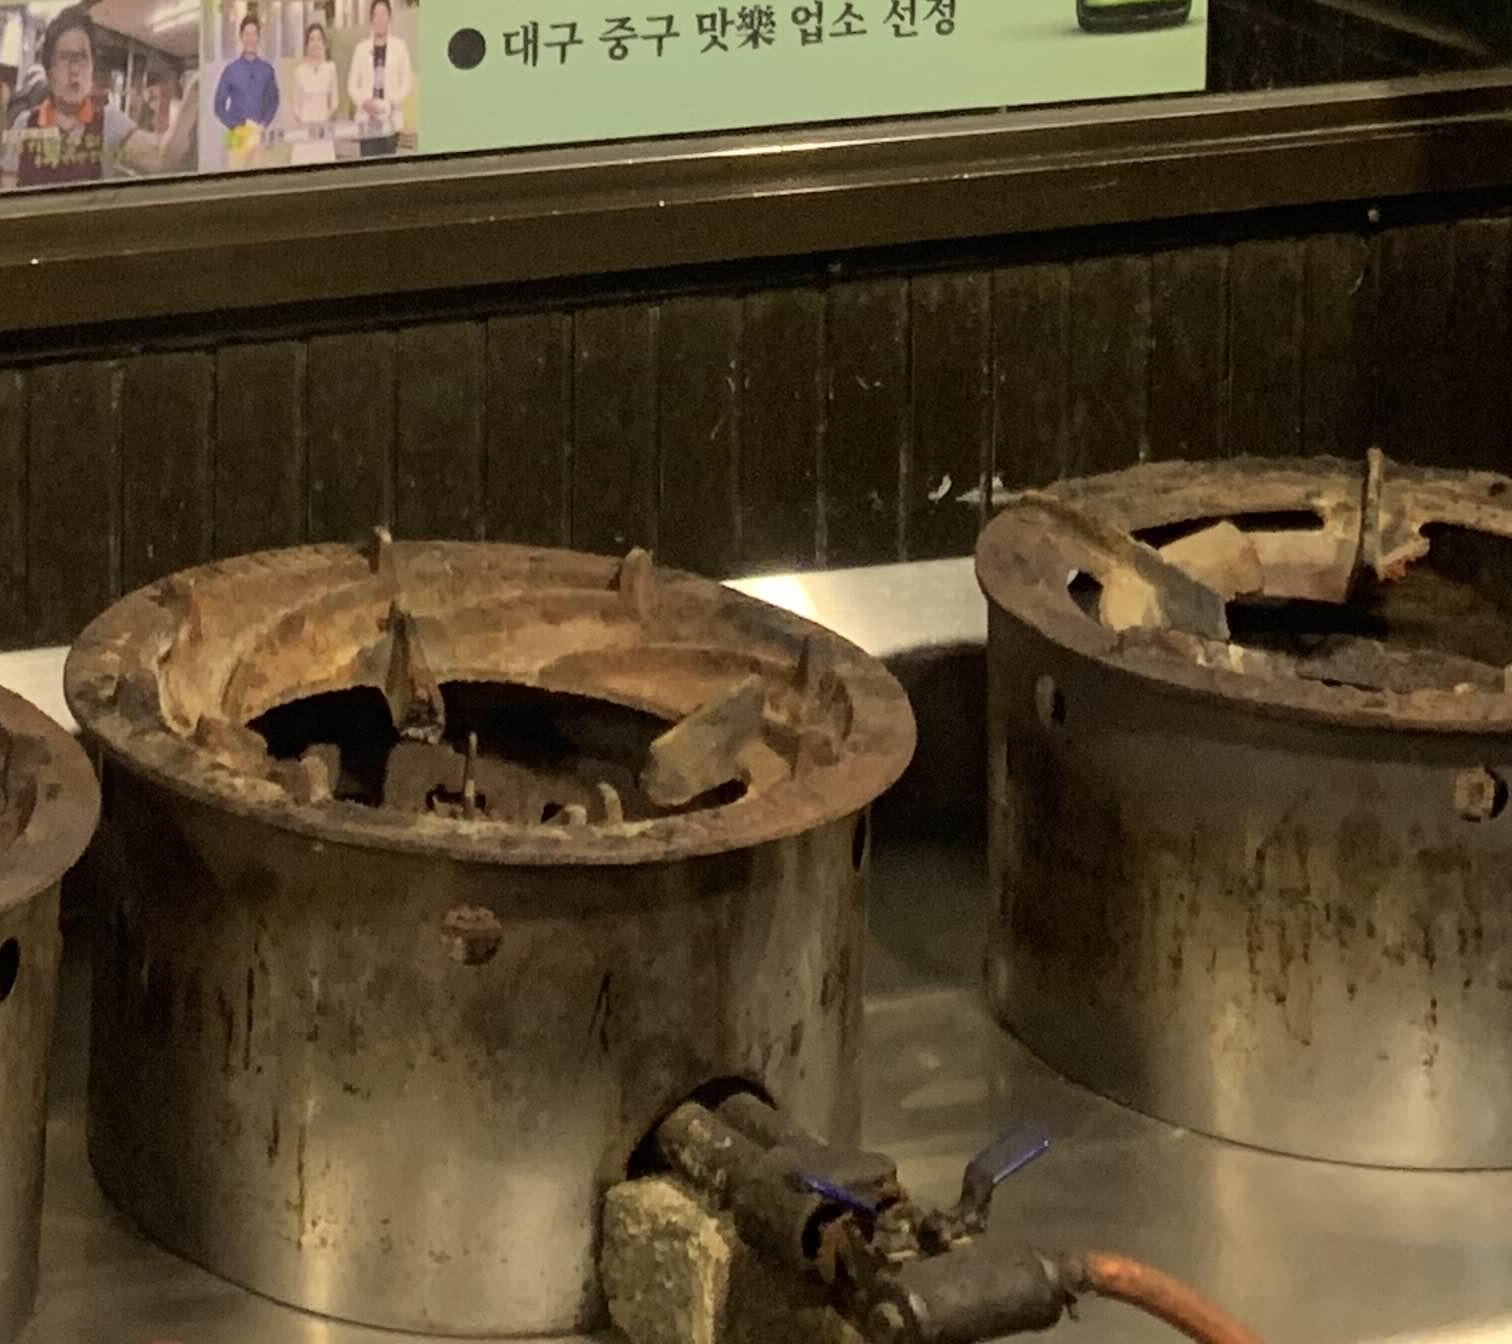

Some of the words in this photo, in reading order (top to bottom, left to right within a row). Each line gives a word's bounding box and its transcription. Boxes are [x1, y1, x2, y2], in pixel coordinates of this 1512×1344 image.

[502, 20, 584, 68] 대구
[598, 14, 681, 61] 중구
[695, 4, 777, 54] 맛樂
[790, 0, 868, 47] 업소
